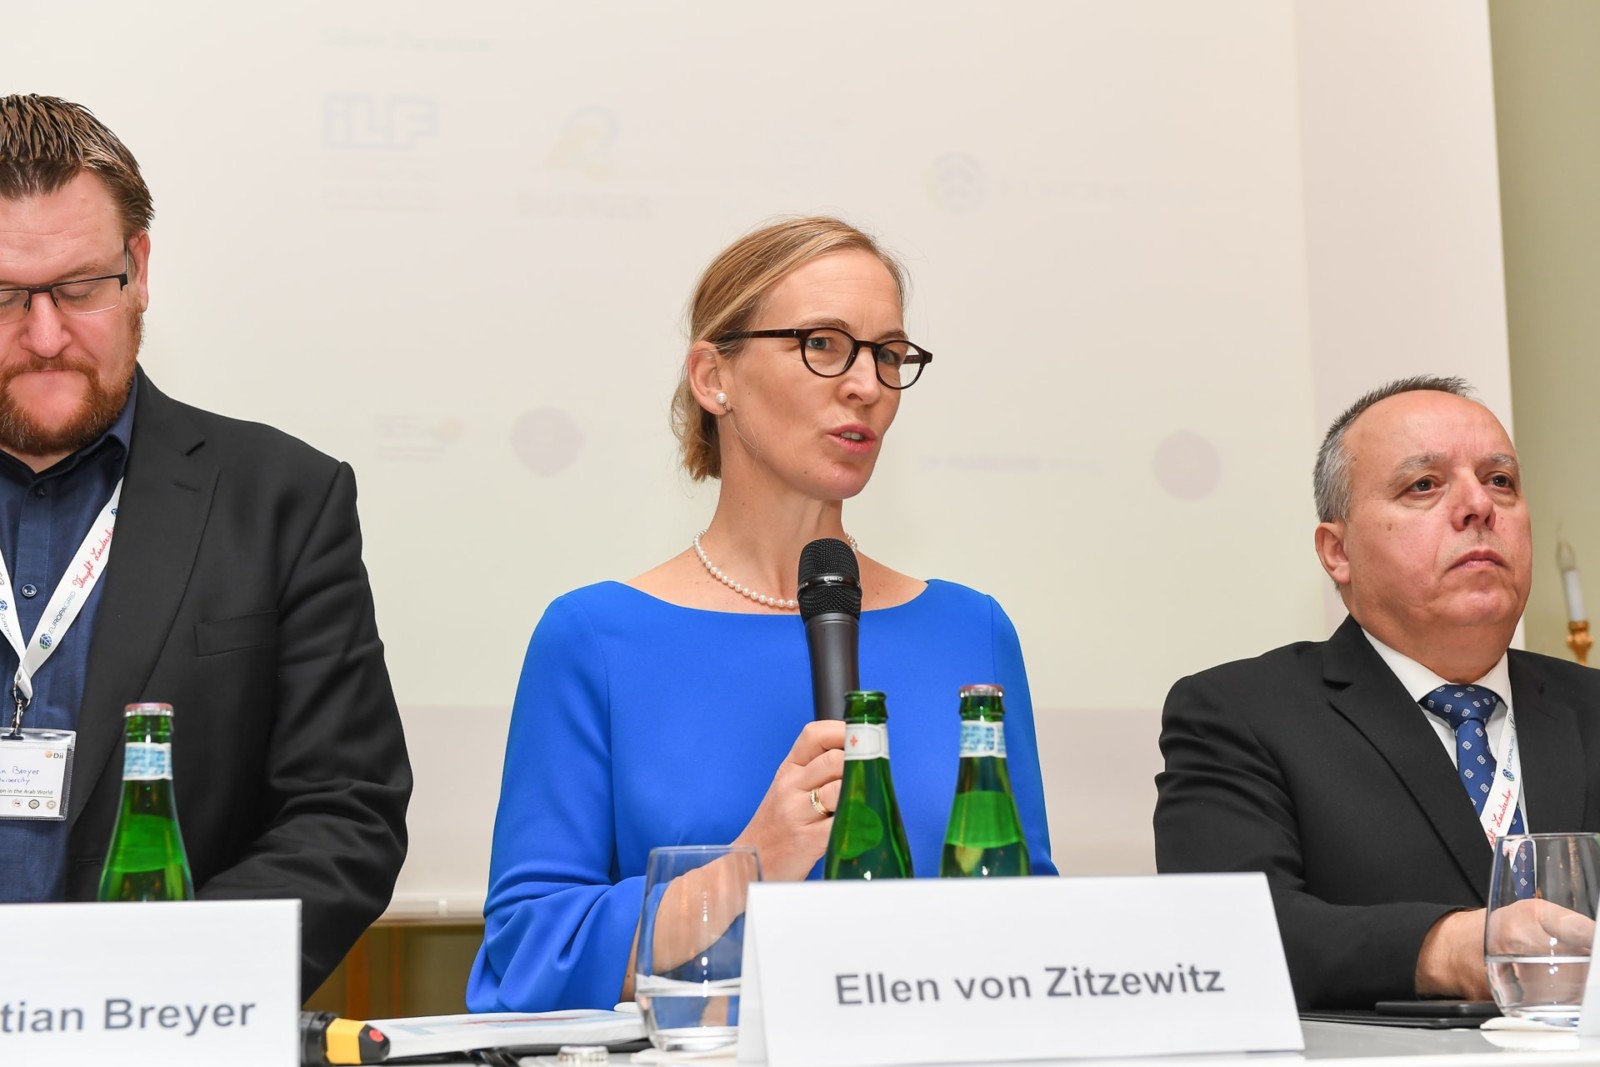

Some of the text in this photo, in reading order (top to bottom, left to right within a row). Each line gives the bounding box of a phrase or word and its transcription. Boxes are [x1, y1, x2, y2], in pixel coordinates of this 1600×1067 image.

[835, 963, 1225, 1006] Ellen von Zitzewitz
[0, 998, 257, 1037] tian Breyer
